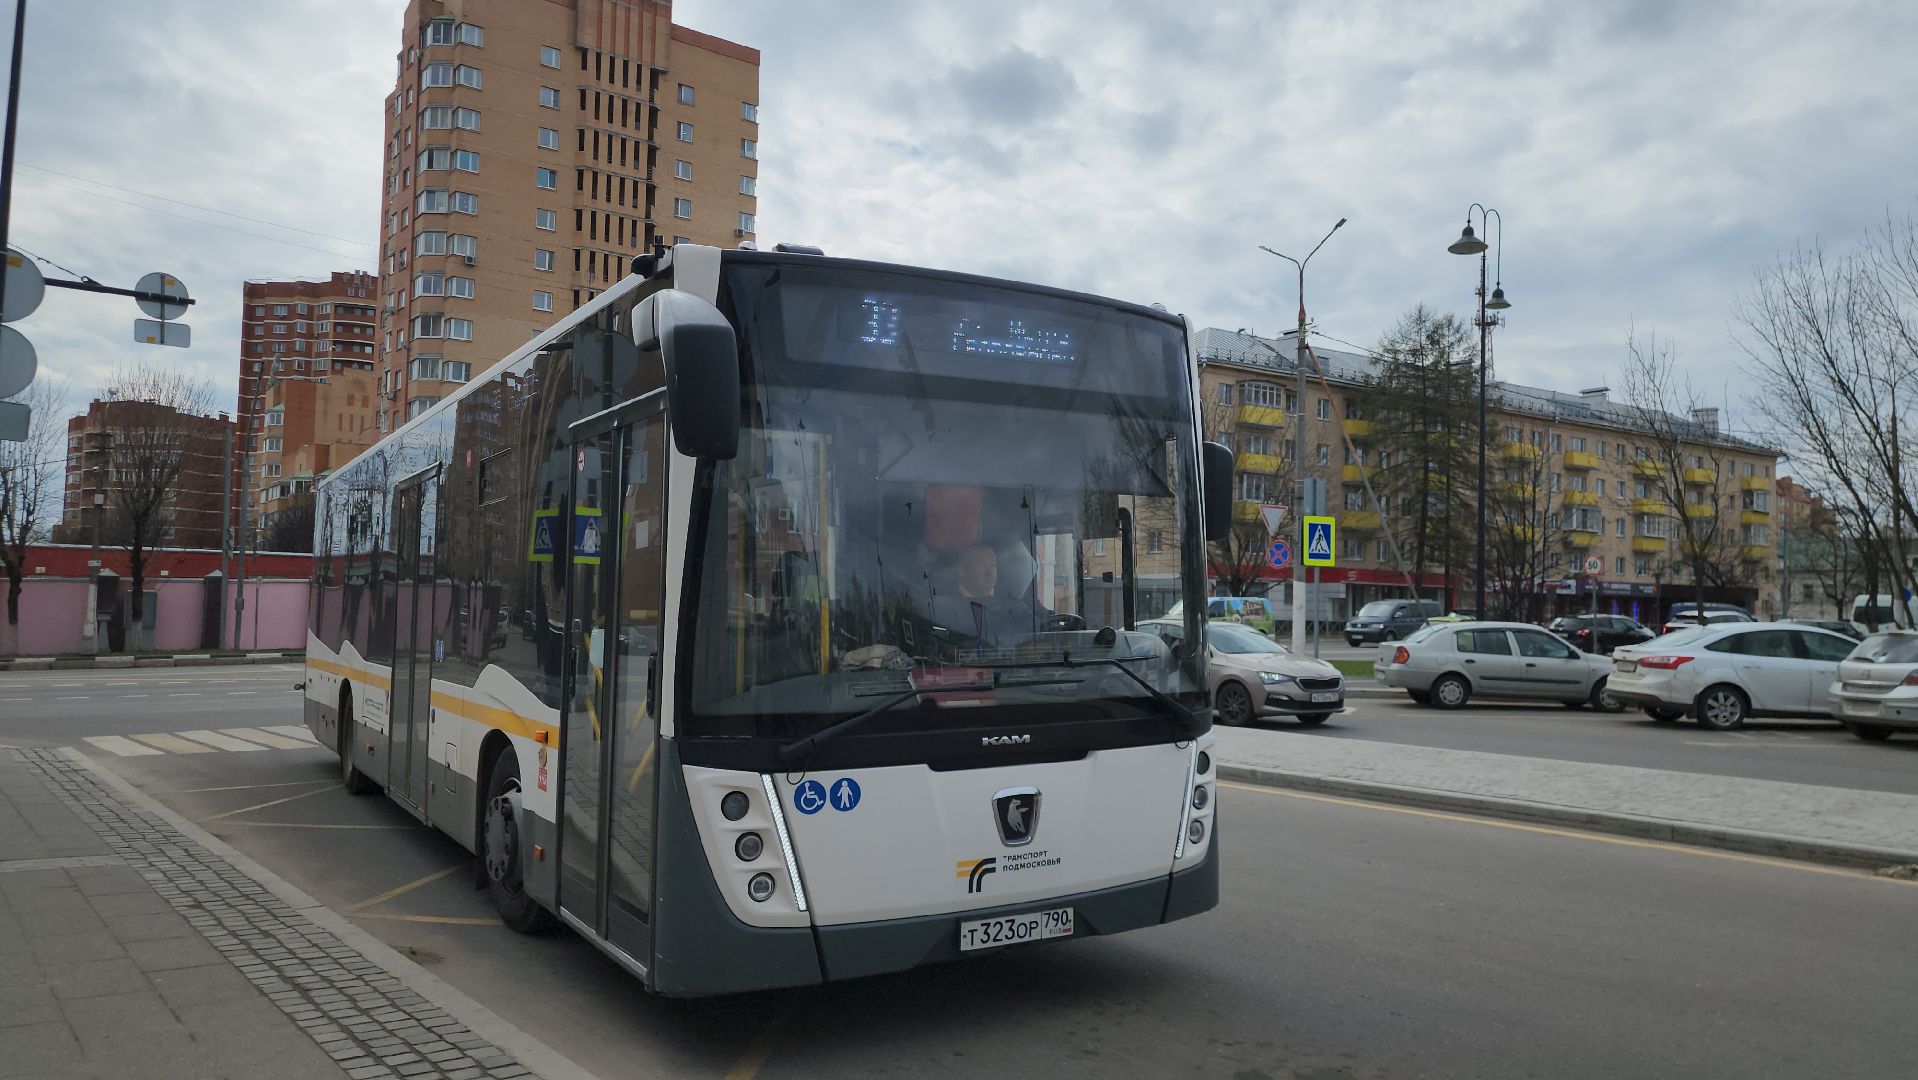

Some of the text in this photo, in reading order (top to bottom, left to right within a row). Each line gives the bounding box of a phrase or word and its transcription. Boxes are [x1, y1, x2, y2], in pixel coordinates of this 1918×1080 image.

[1003, 850, 1048, 863] ТРАНСПОРТ
[1003, 857, 1061, 872] ПОДМОСКОВЬЯ
[968, 909, 1069, 947] Т323ОР 790
